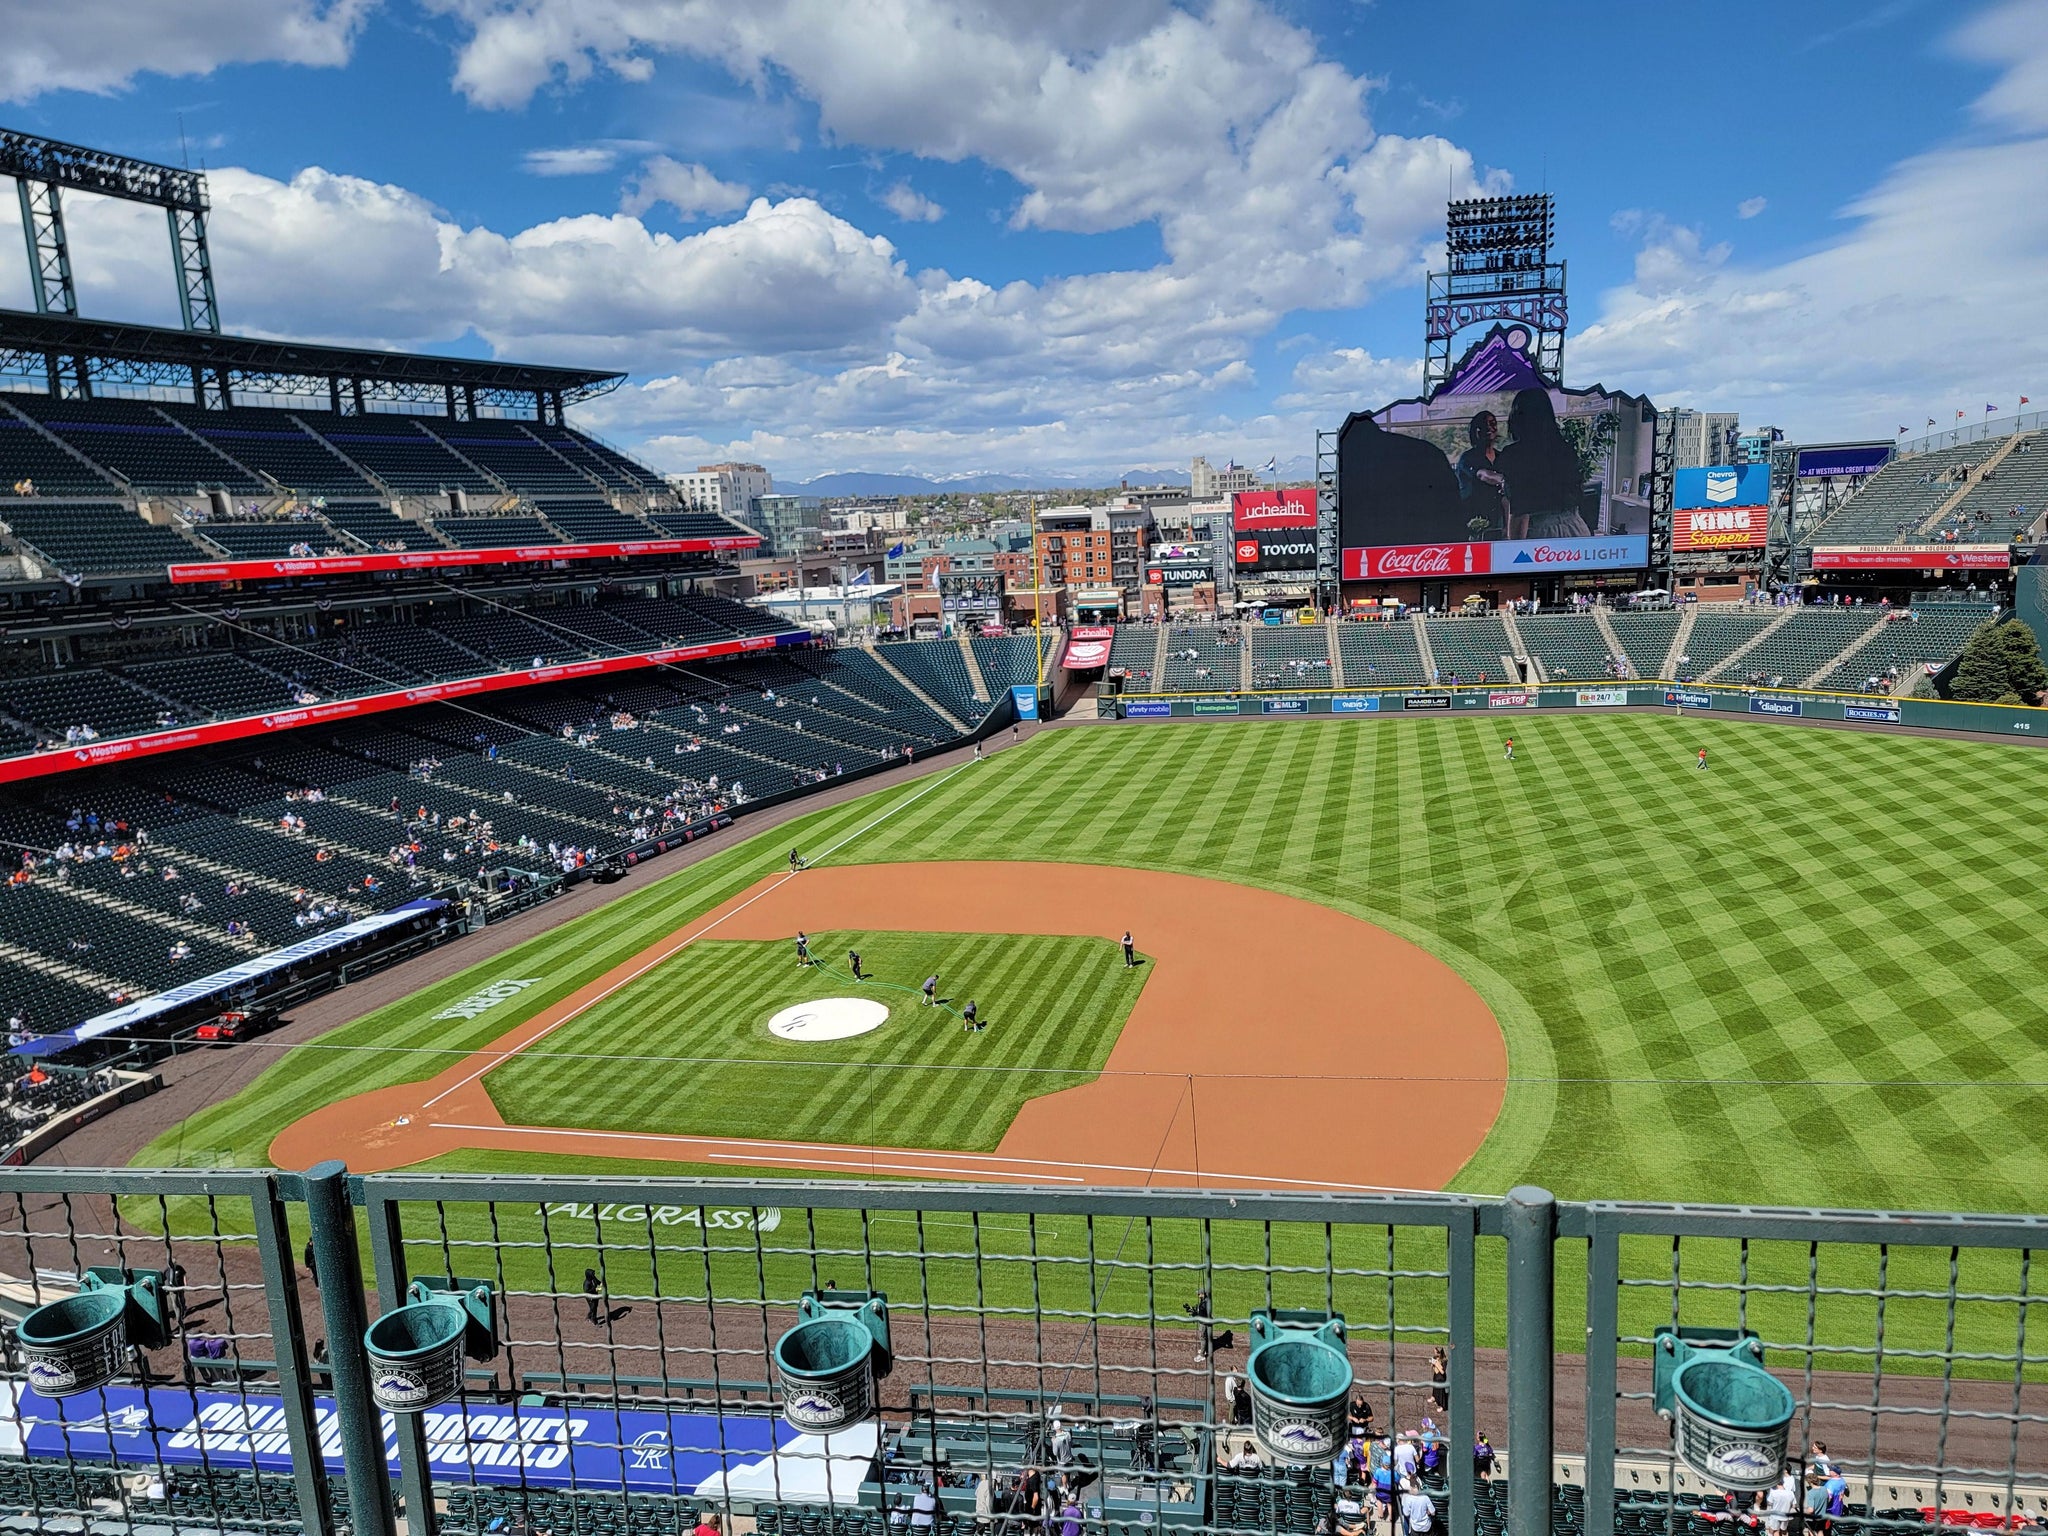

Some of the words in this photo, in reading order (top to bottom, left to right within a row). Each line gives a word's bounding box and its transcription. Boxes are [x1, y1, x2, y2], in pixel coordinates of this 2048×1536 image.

[1428, 296, 1568, 338] ROCKIES
[1816, 467, 1844, 475] WESTERRA
[1845, 466, 1864, 474] CREDIT
[1246, 500, 1305, 517] uchealth
[1690, 511, 1750, 531] KING
[1689, 531, 1751, 547] Soopers
[1262, 544, 1315, 556] TOYOTA
[1534, 545, 1581, 563] Coors
[1584, 548, 1629, 561] LIGHT
[1961, 554, 2009, 562] Westerra
[1378, 547, 1453, 574] Coca-Cola
[1162, 571, 1206, 581] TUNDRA
[1128, 705, 1148, 714] xfinity
[1149, 705, 1169, 713] mobile
[1761, 702, 1793, 714] dialpad
[2014, 722, 2030, 730] 415
[535, 1203, 751, 1230] ALLGRASS
[375, 1369, 421, 1386] COLORADO
[789, 1389, 838, 1406] COLORADO
[790, 1406, 845, 1421] ROCKIES
[1274, 1418, 1328, 1436] COLORADO
[1272, 1434, 1331, 1452] ROCKIES
[1714, 1442, 1776, 1463] COLORADO
[1711, 1460, 1777, 1478] ROCKIES
